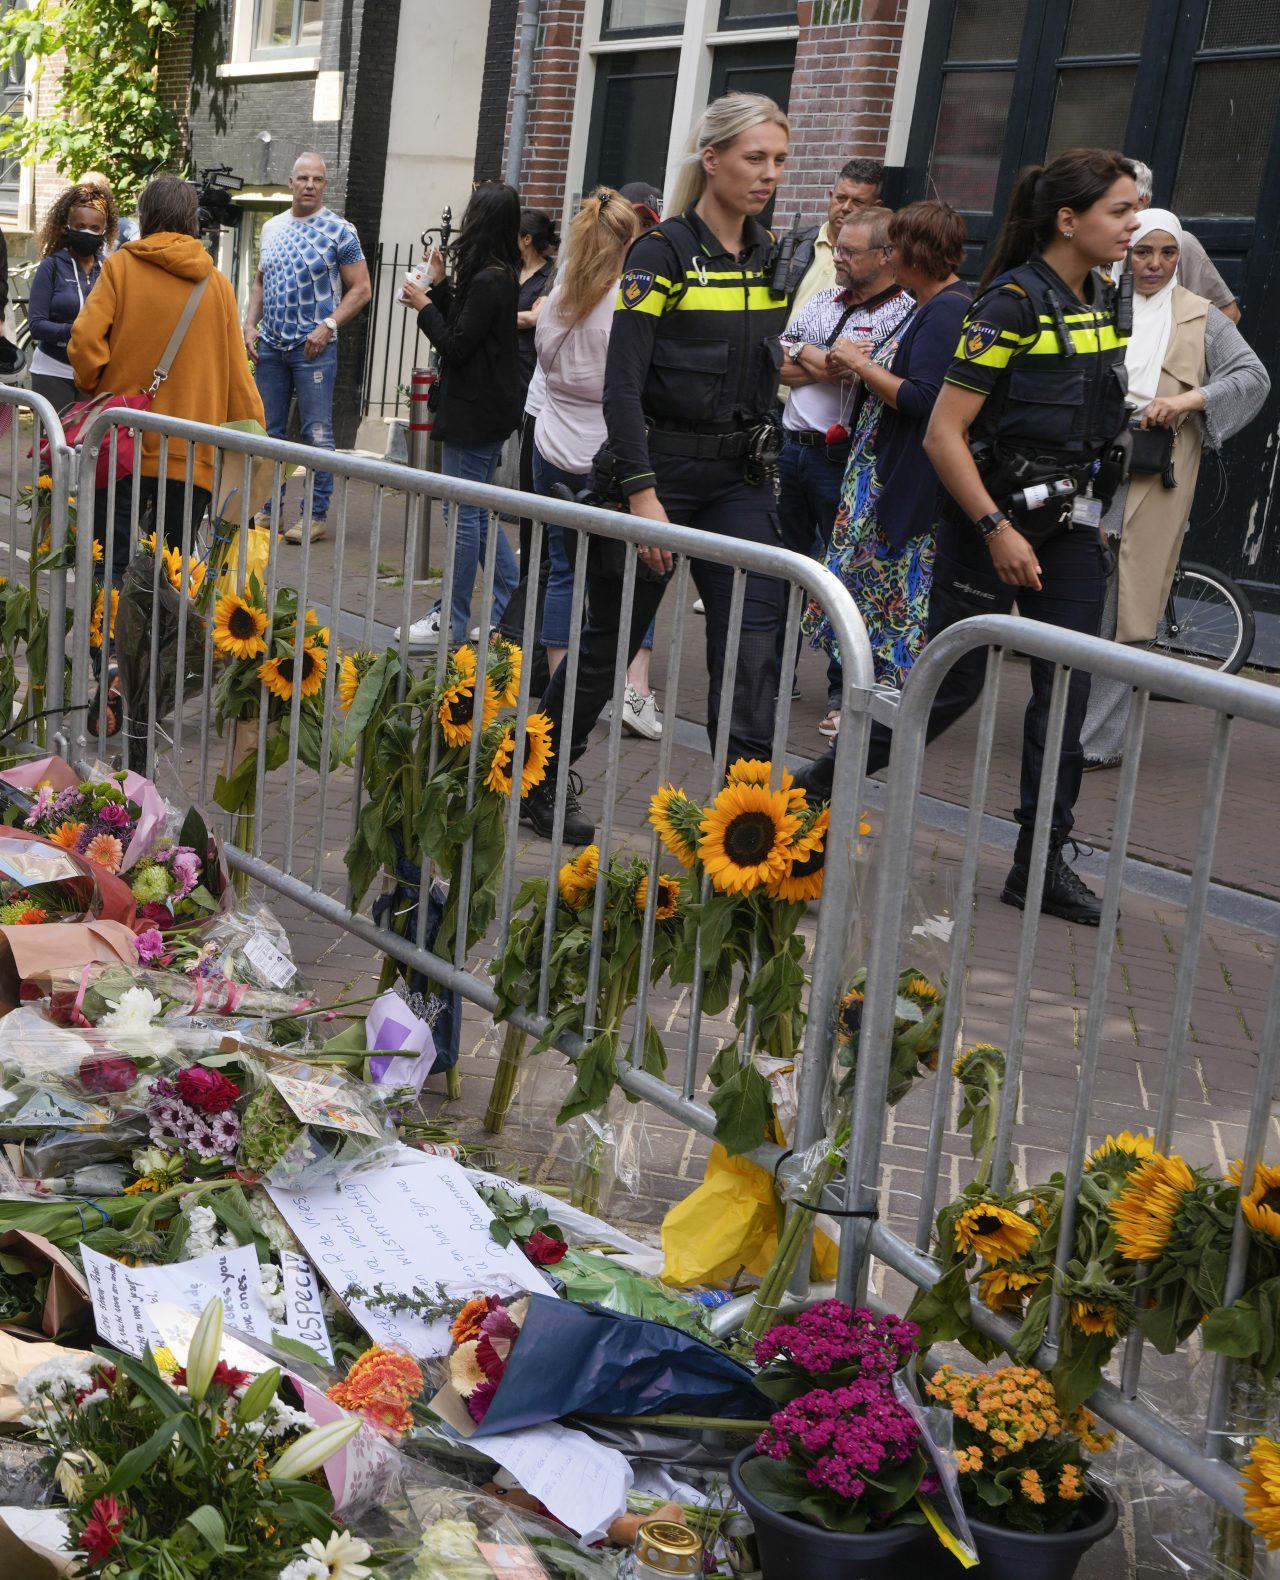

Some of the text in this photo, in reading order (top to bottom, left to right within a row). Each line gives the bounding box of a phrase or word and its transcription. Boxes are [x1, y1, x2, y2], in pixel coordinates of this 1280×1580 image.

[625, 272, 651, 281] POLITIE
[424, 1222, 450, 1246] hart
[218, 1255, 235, 1285] you
